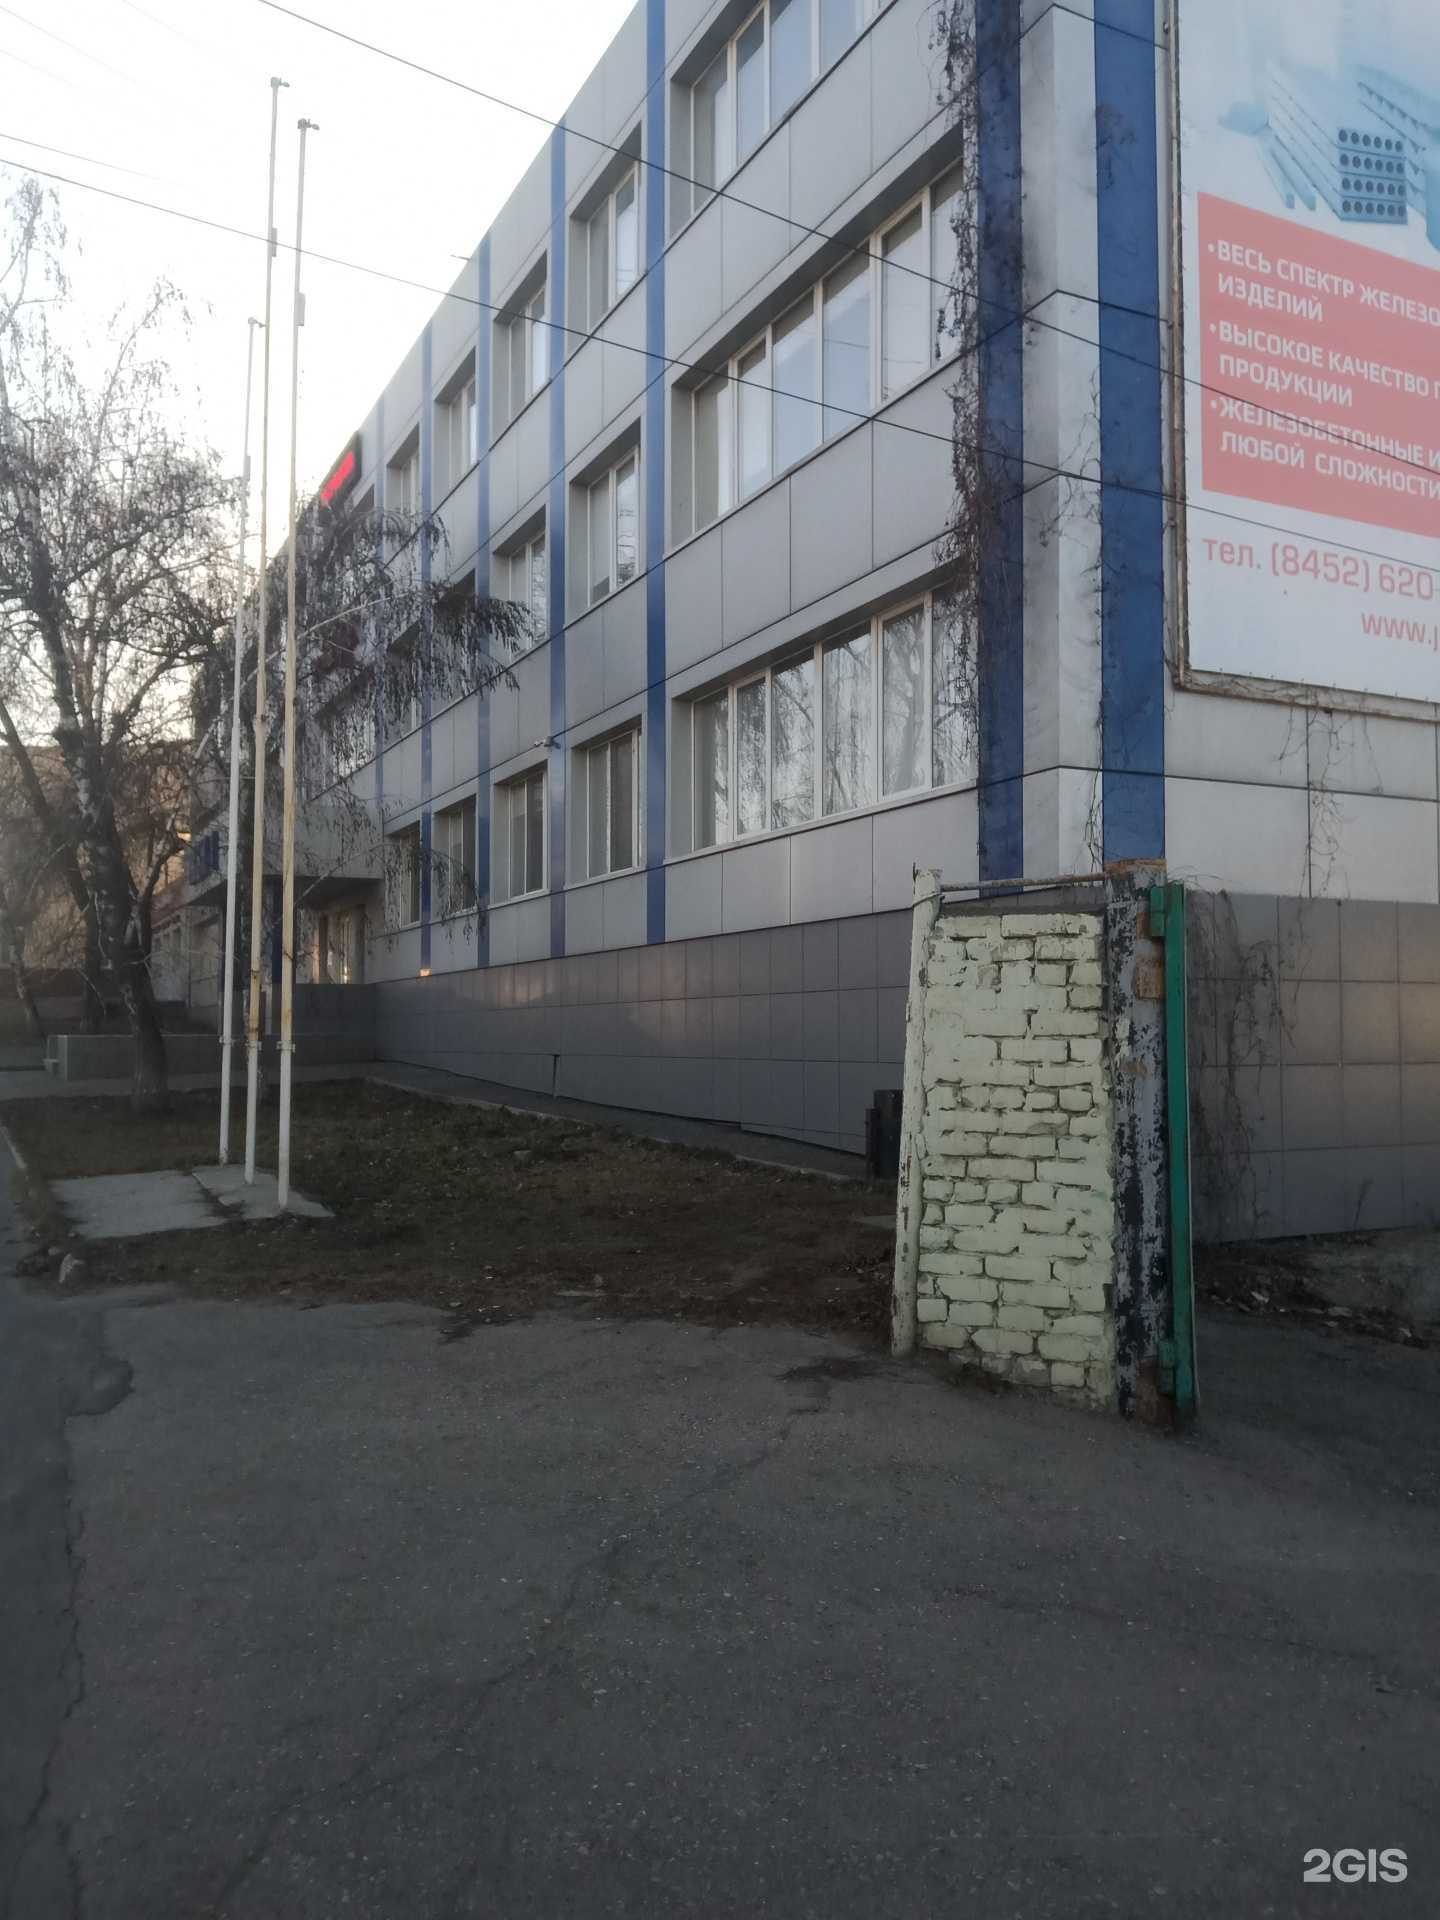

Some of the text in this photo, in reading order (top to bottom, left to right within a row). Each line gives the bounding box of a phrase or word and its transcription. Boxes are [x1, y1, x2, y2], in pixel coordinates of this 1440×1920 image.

[1218, 239, 1271, 274] ВЕСЬ
[1278, 258, 1354, 299] СПЕКТР
[1218, 272, 1323, 322] ИЗДЕЛИЙ
[1220, 320, 1323, 368] ВЫСОКОЕ
[1328, 347, 1429, 397] КАЧЕСТВО
[1220, 354, 1352, 405] ПРОДУКЦИИ
[1220, 397, 1424, 466] ЖЕЛЕЗОБЕТОННЫЕ
[1221, 431, 1440, 499] ЛЮБОЙ СЛОЖНОСТИ
[1202, 539, 1261, 570] тел.
[1271, 543, 1371, 593] (8452)
